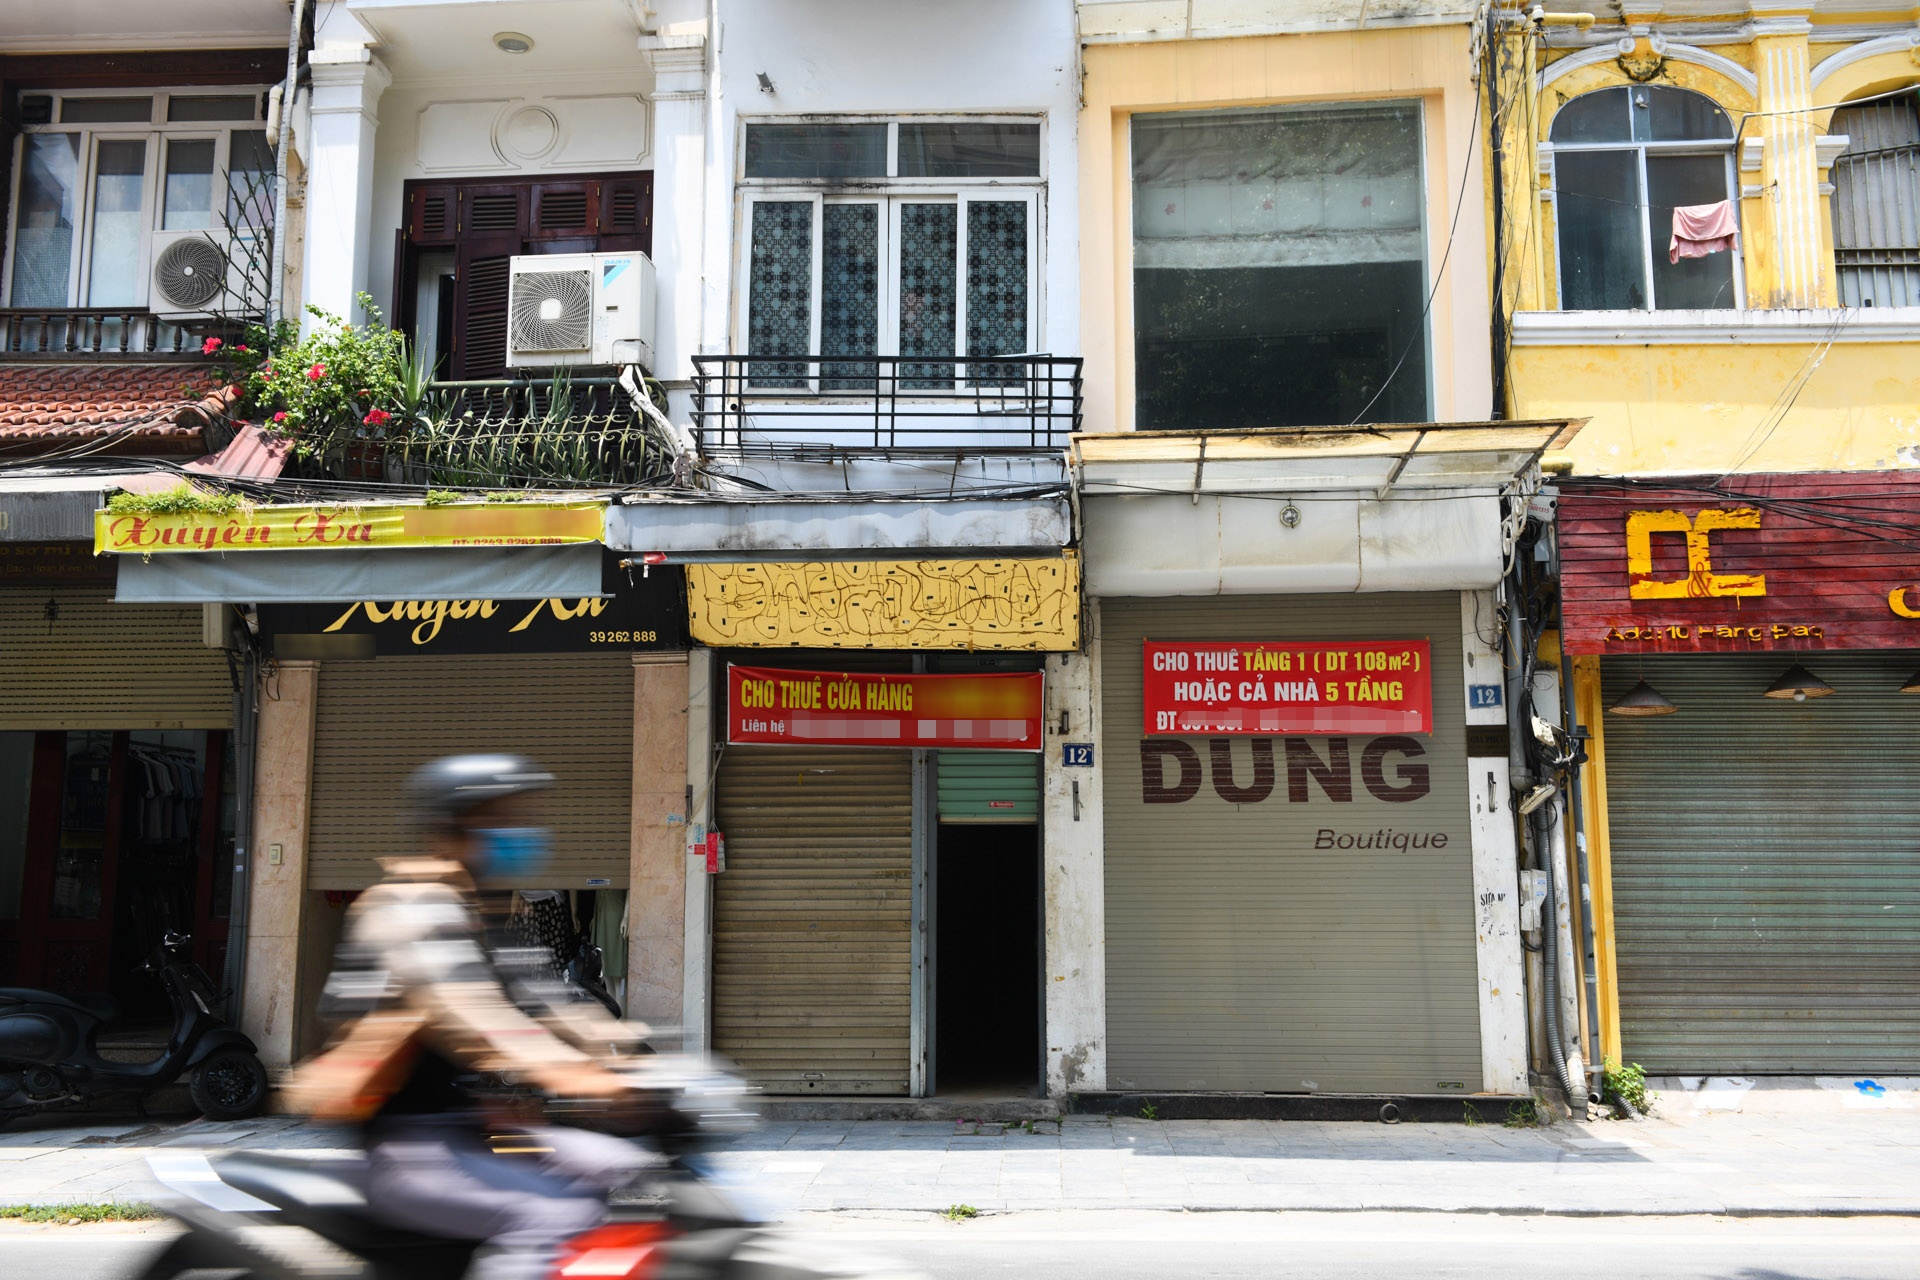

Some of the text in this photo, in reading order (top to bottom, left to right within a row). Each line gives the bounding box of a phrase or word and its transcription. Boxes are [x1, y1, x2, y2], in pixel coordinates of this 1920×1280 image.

[109, 512, 377, 550] Xuyên Xa
[633, 631, 657, 642] 888
[1153, 651, 1189, 672] CHO
[1194, 648, 1239, 672] THUÊ
[1243, 645, 1291, 672] TẦNG
[1297, 652, 1305, 671] 1
[1326, 651, 1348, 671] DT
[741, 672, 913, 711] CHO THUÊ CỬA HÀNG
[1174, 673, 1403, 706] HOẶC CẢ NHÀ 5 TẦNG
[1477, 688, 1496, 704] 12
[742, 719, 785, 735] Liên hệ
[1156, 711, 1176, 731] ĐT
[1069, 747, 1088, 764] 12
[1140, 737, 1431, 804] DUNG
[1314, 828, 1449, 854] Boutique
